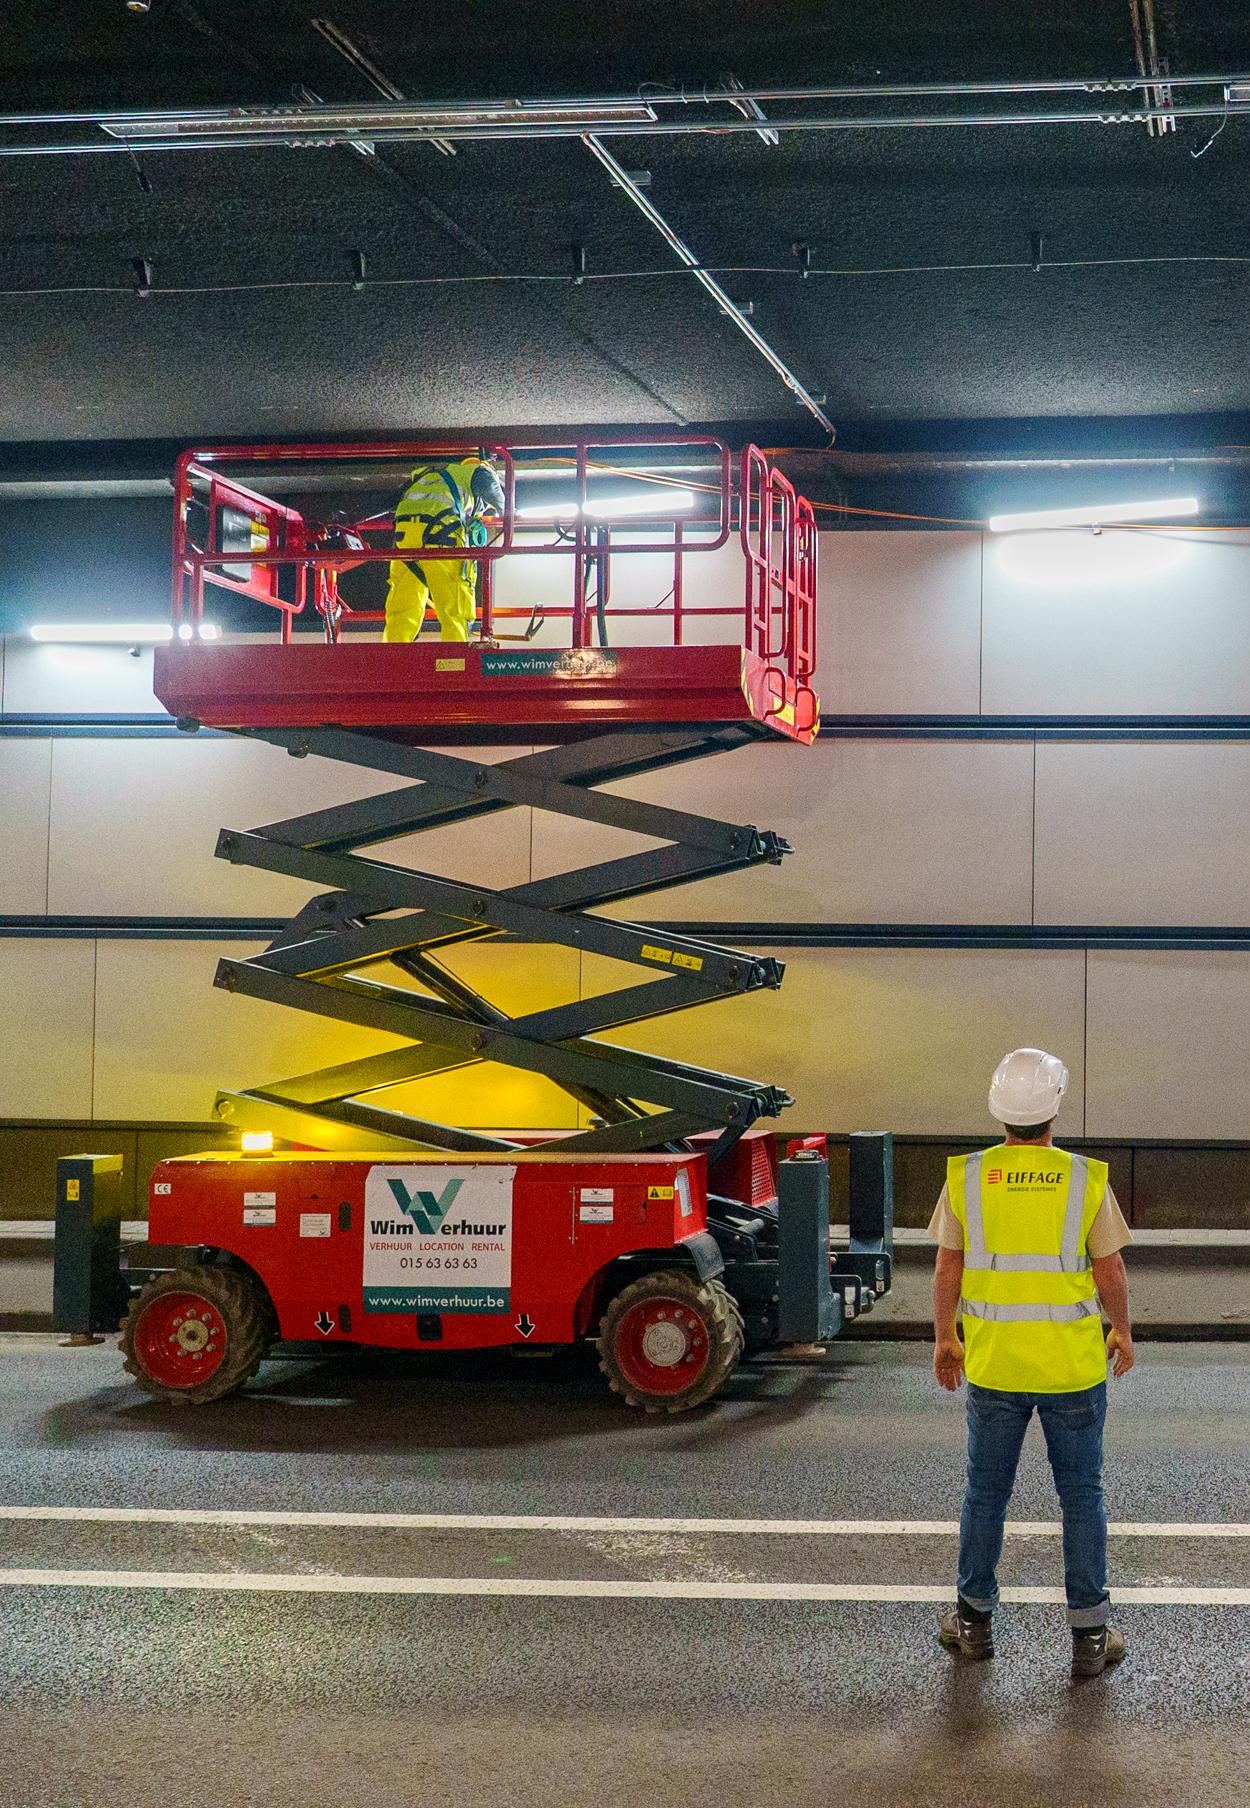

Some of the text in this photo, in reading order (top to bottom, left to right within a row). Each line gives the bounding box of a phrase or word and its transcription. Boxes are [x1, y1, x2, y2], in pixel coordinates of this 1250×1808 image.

[1007, 1172, 1064, 1184] EIFFAGE
[369, 1242, 505, 1251] VERHUUR LOCATION RENTAL
[400, 1257, 478, 1269] 015 63 63 63
[368, 1295, 505, 1308] www.wimverhuur.be
